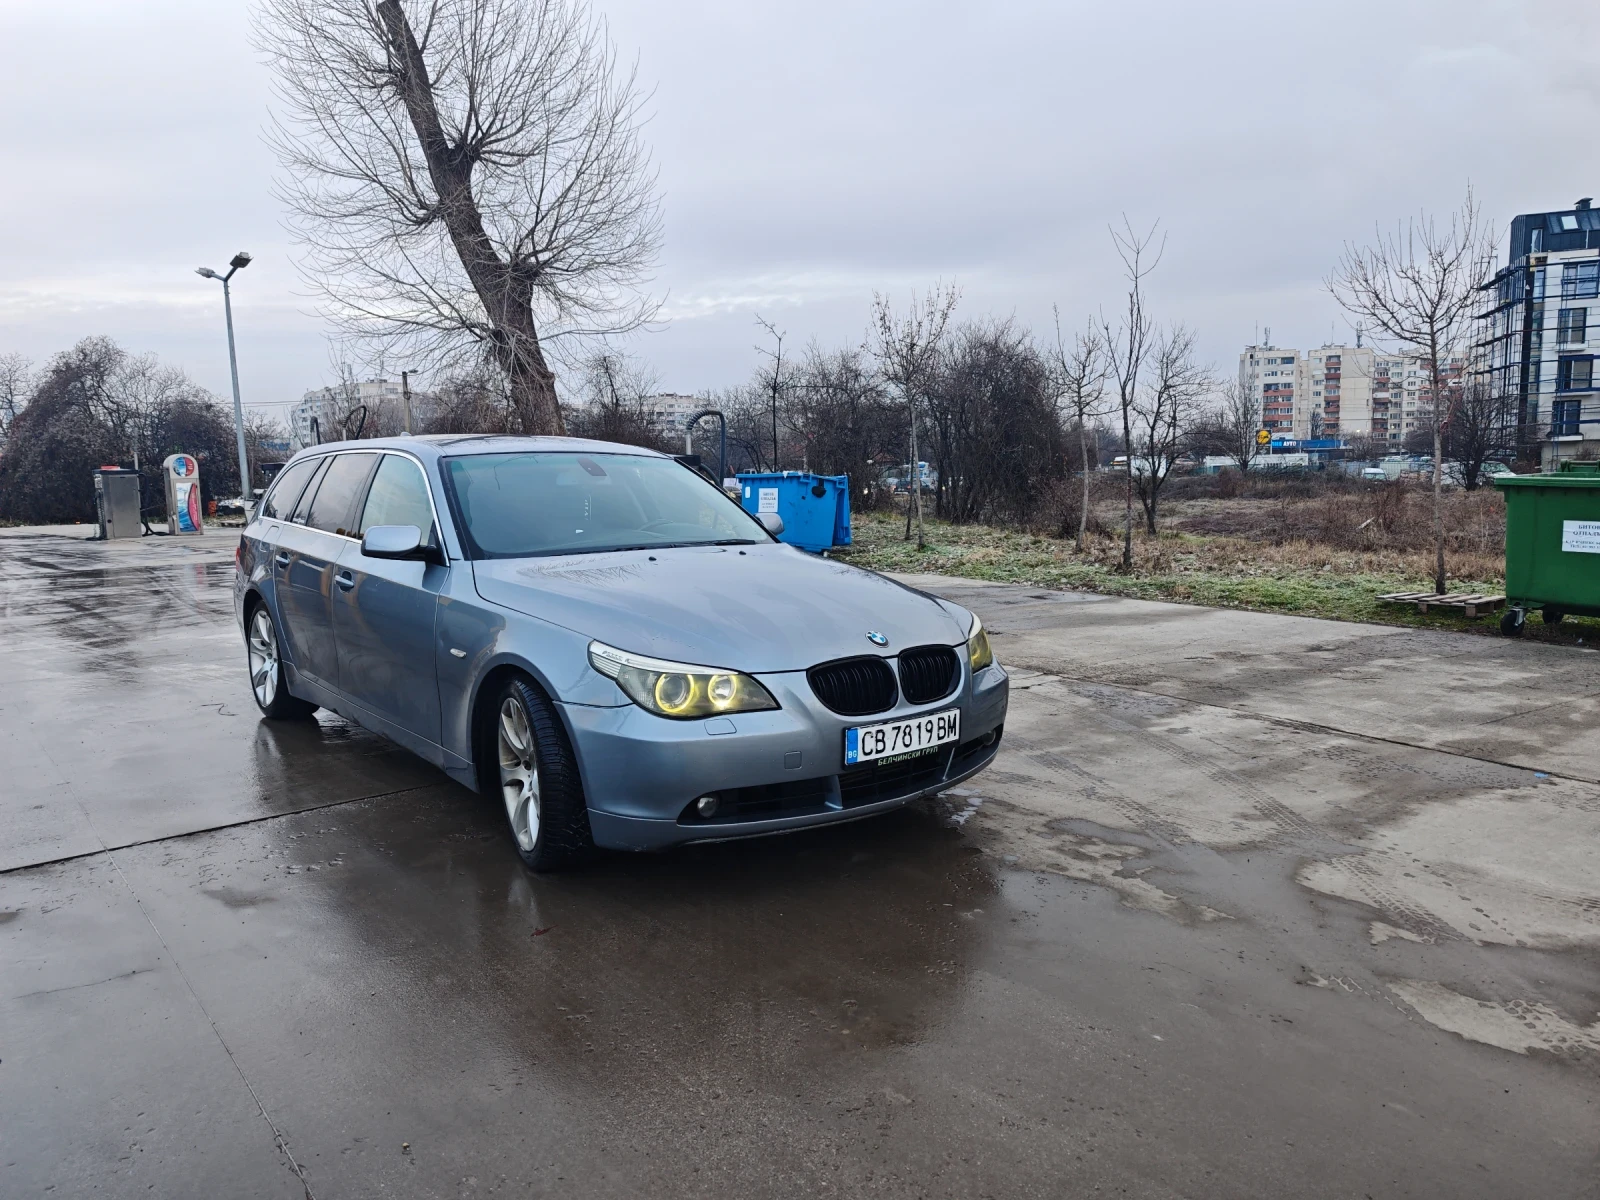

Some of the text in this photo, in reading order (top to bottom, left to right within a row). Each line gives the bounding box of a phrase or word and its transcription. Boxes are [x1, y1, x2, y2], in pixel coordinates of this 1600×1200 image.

[848, 750, 858, 759] BG
[877, 746, 938, 766] БЕЛЧИНСКИ ГРУП
